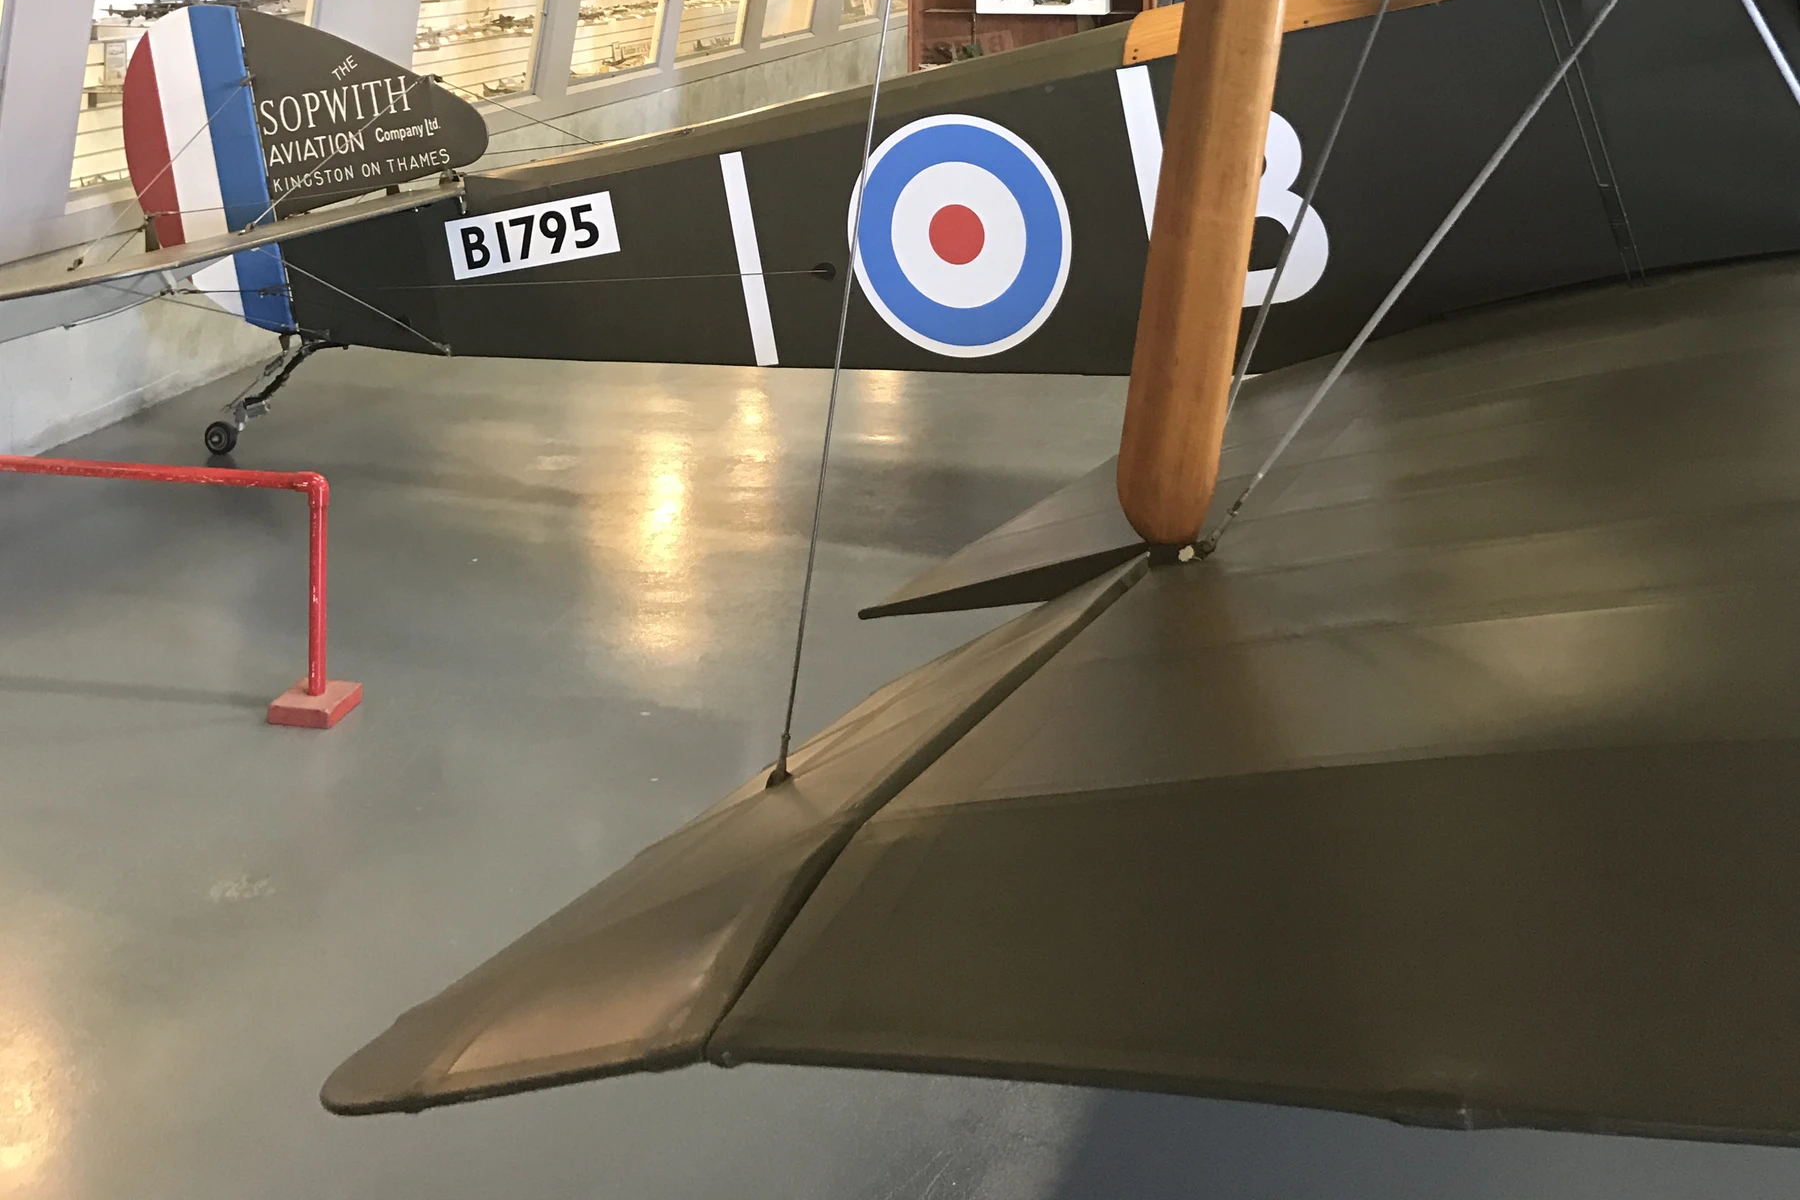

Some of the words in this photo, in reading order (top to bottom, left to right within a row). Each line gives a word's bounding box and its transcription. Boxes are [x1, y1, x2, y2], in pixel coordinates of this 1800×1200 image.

[331, 55, 359, 81] THE
[260, 75, 412, 136] SOPWITH
[269, 129, 365, 167] AVIATION
[375, 123, 424, 143] Company
[273, 164, 355, 193] KINGSTON
[362, 161, 382, 178] ON
[386, 148, 451, 173] THAMES
[460, 203, 600, 270] B1795
